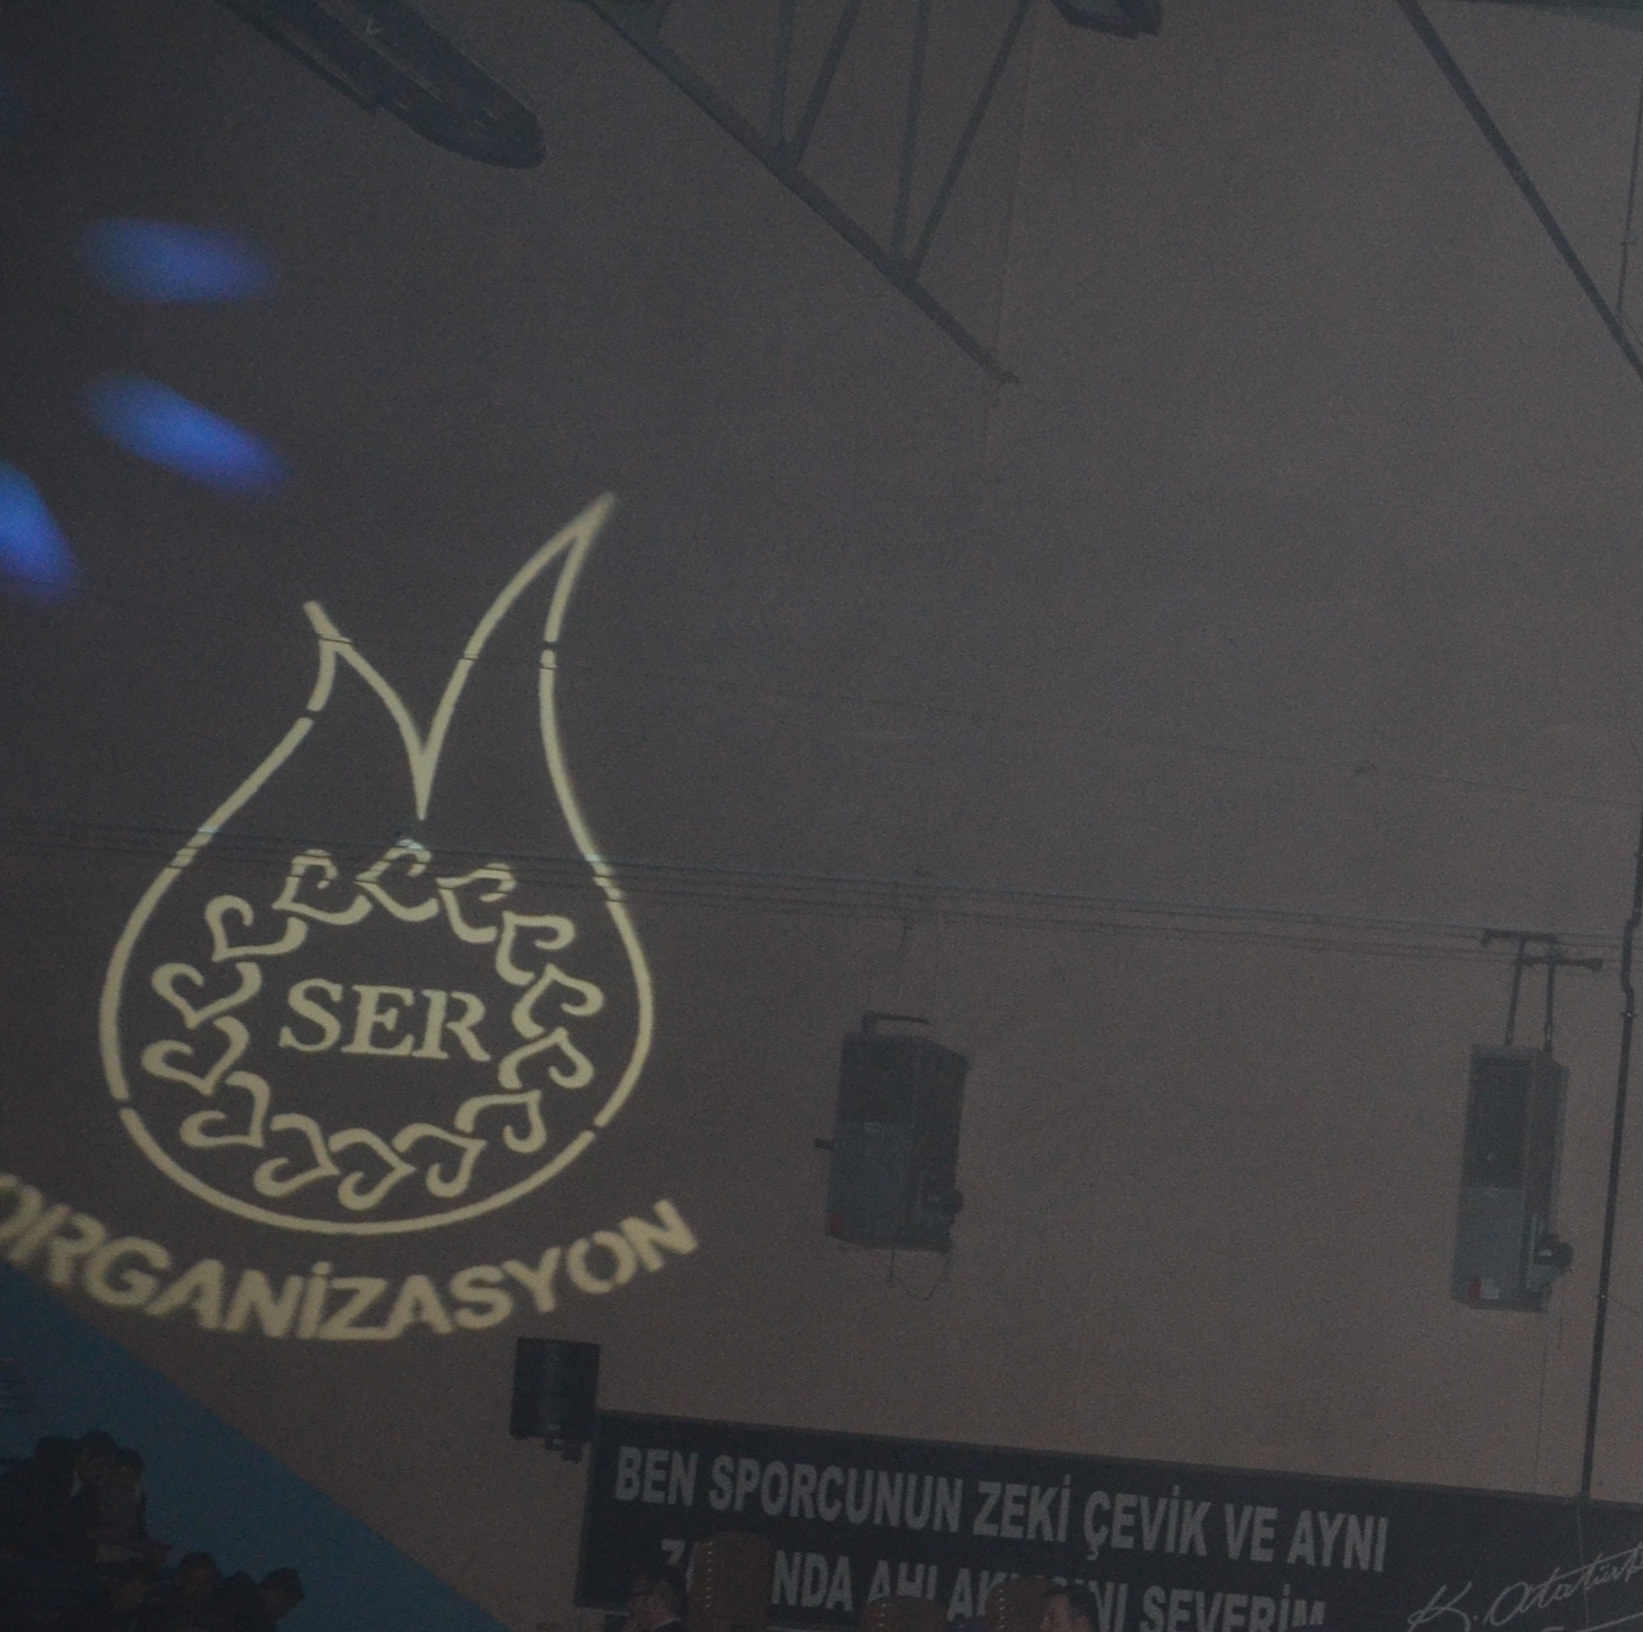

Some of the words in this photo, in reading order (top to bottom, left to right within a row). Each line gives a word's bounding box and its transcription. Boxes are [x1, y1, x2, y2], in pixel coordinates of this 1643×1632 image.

[279, 978, 490, 1060] SER
[615, 1446, 699, 1508] BEN
[708, 1455, 964, 1533] SPORCUNUN
[973, 1473, 1071, 1543] ZEKİ
[1083, 1484, 1211, 1561] ÇEVİK
[1224, 1503, 1278, 1563] VE
[1286, 1509, 1389, 1573] AYNI
